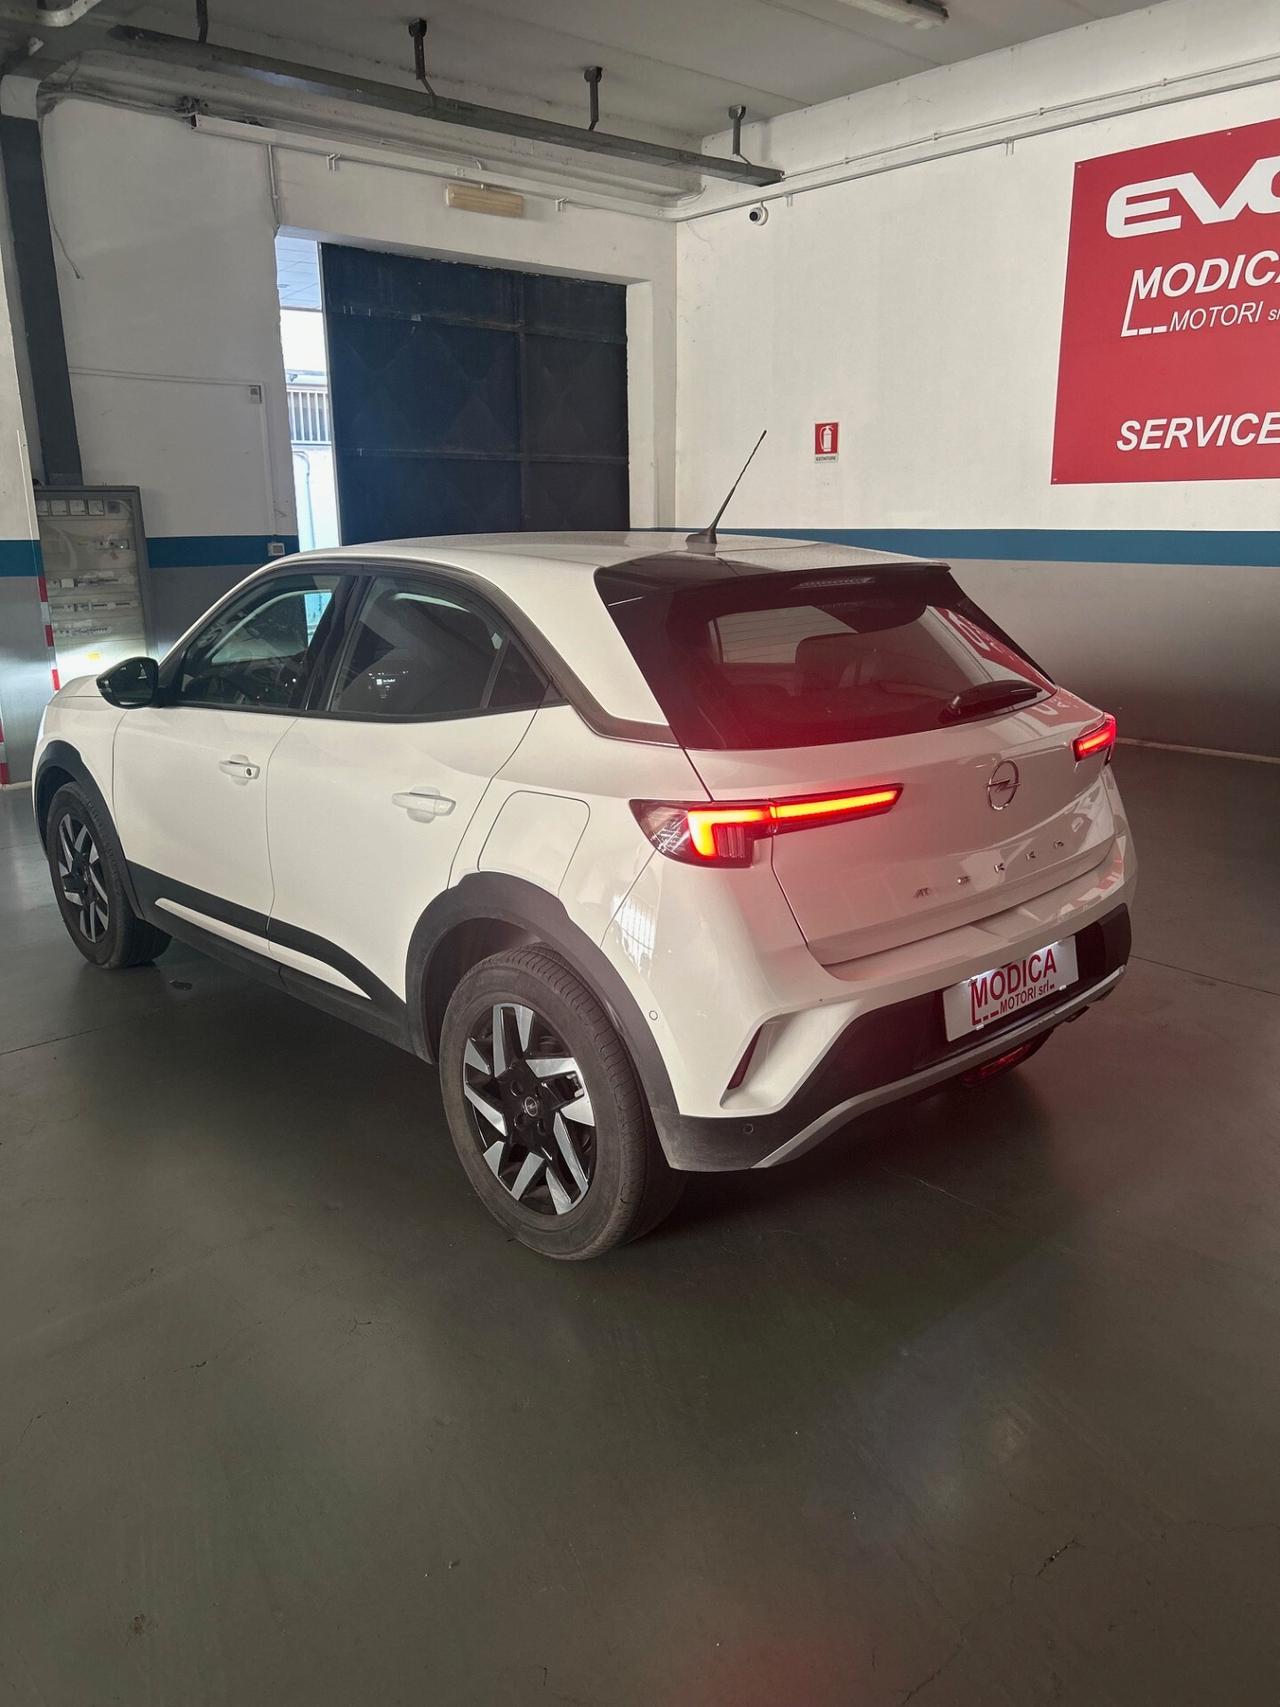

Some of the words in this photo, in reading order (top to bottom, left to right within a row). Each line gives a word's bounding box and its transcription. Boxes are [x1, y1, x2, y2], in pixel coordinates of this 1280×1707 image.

[1129, 250, 1280, 302] MODIC
[1169, 301, 1264, 332] MOTORI
[1116, 412, 1280, 451] SERVICE
[969, 948, 1057, 1010] MODICA
[999, 986, 1037, 1014] MOTORI
